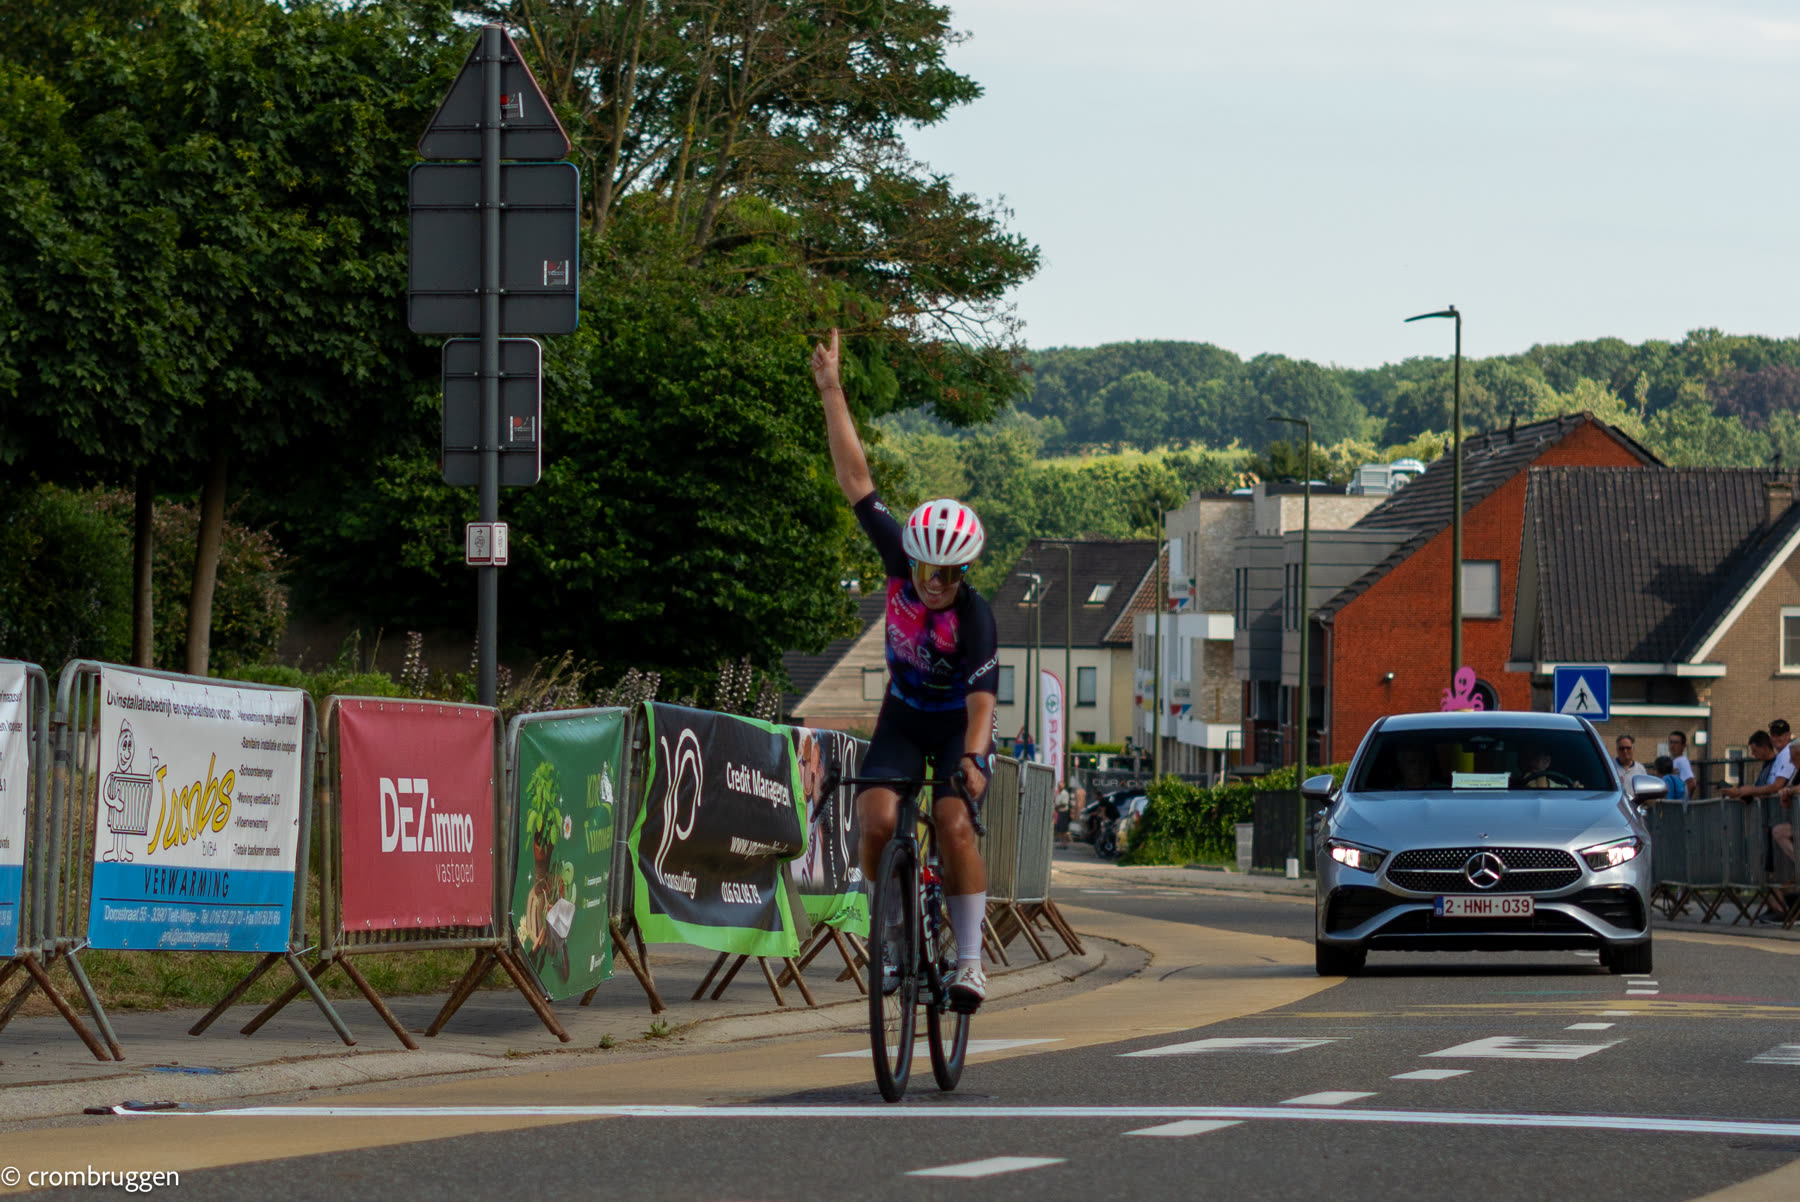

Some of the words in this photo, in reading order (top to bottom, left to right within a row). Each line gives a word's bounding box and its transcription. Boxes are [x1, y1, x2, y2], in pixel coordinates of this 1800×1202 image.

[726, 761, 752, 794] Credit
[144, 867, 230, 898] VERWARMING
[435, 858, 474, 888] vastgoed
[664, 871, 697, 900] consulting
